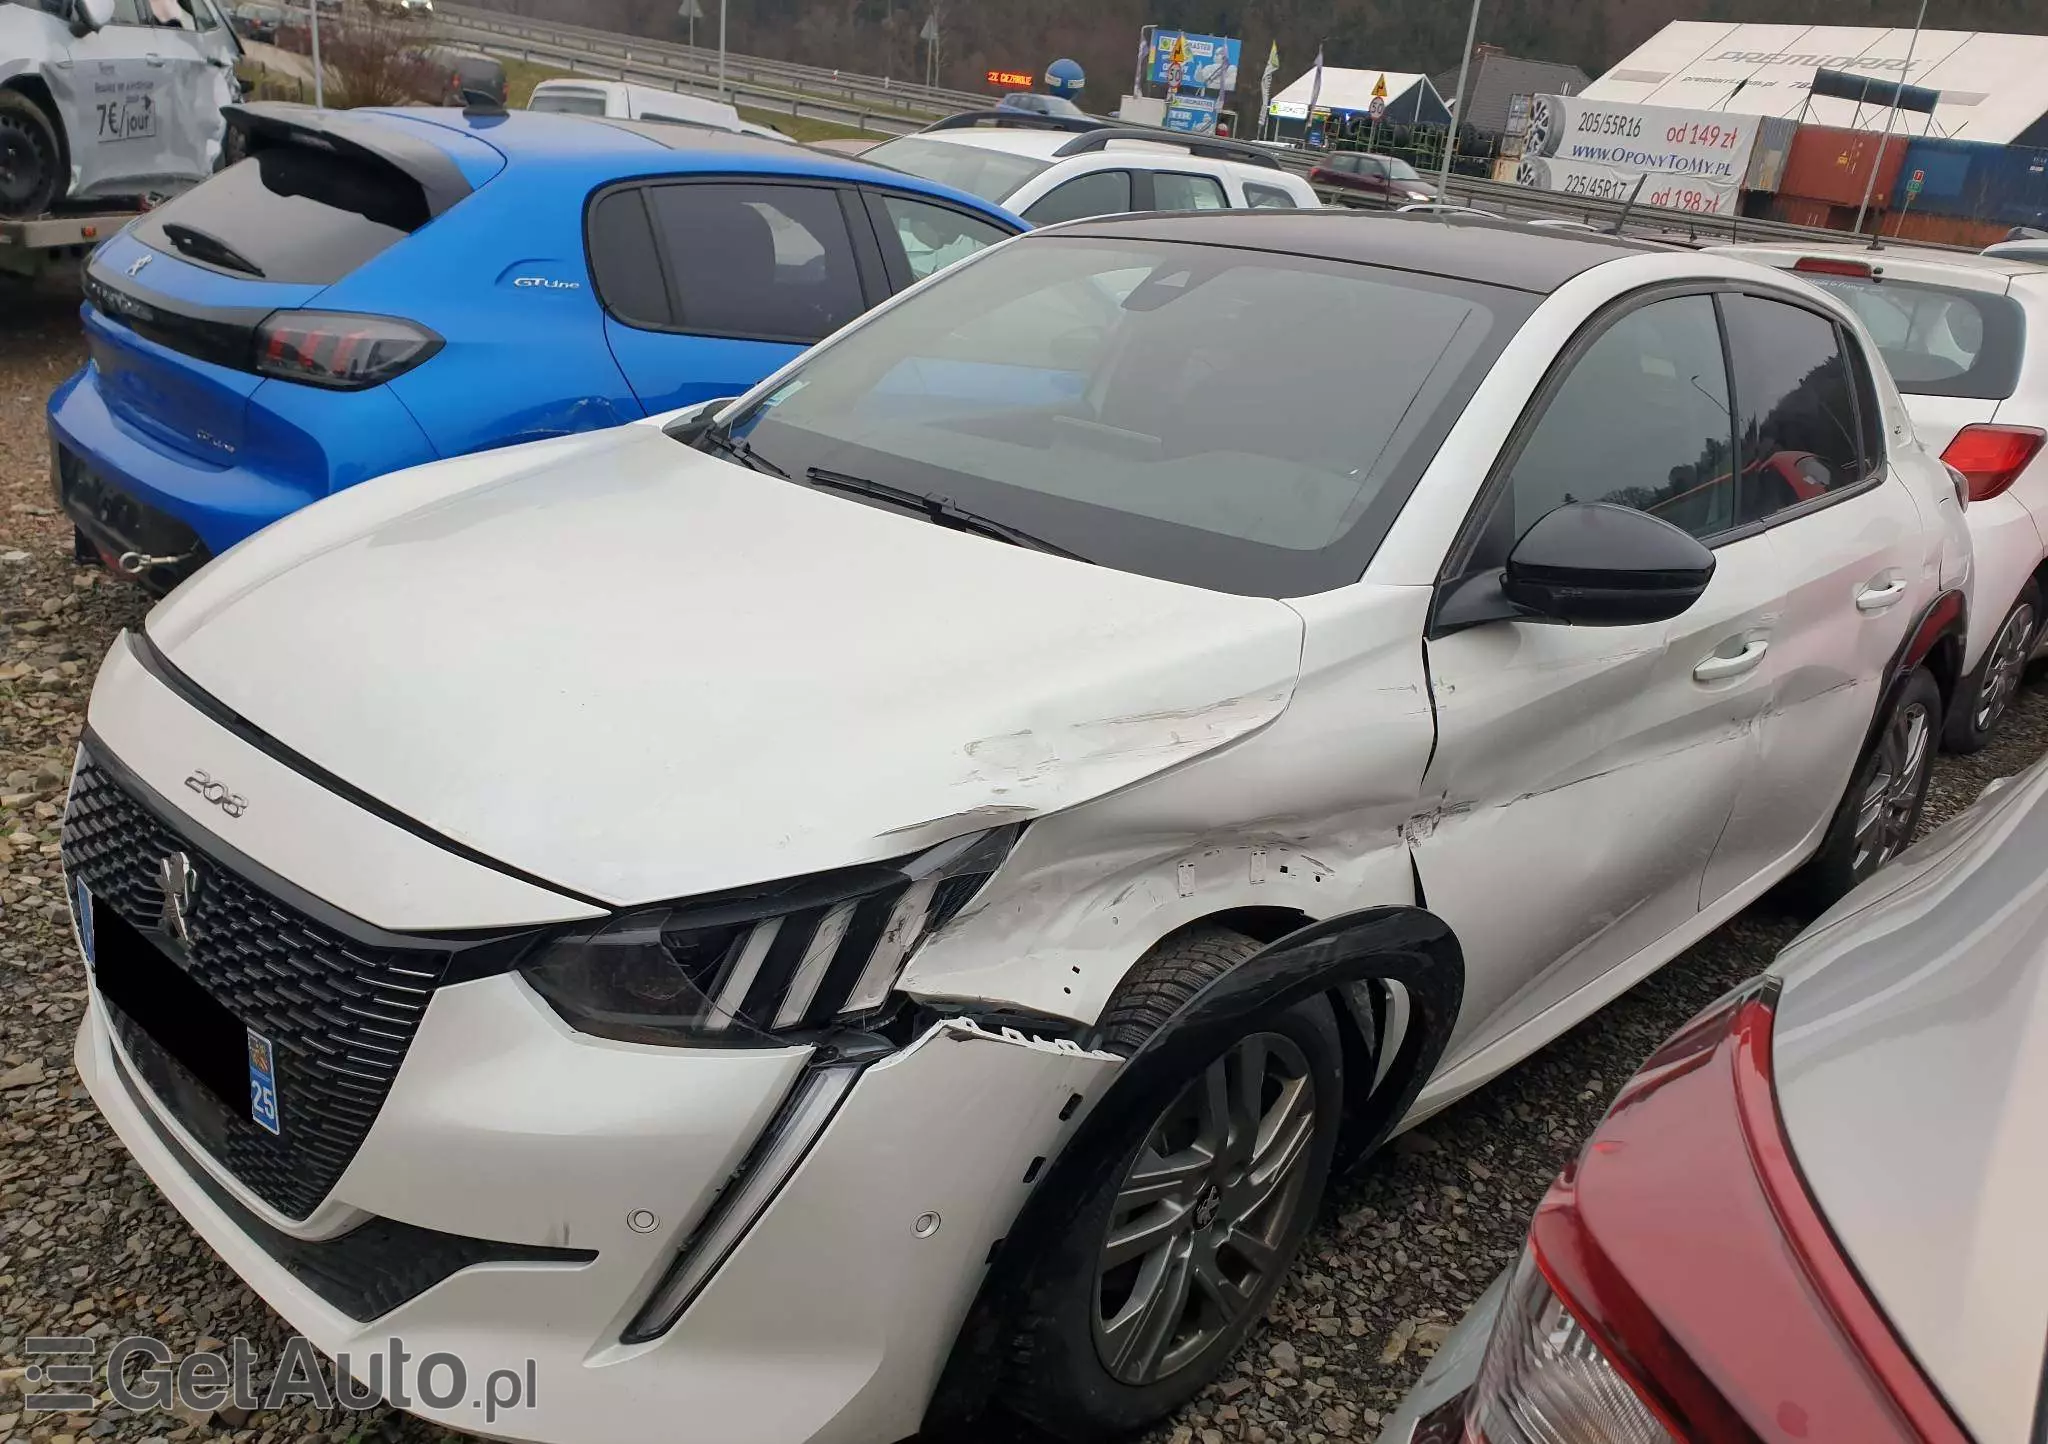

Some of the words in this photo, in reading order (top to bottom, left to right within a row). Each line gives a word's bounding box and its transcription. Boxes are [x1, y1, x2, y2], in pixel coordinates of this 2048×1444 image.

[97, 101, 150, 138] 7€/jour
[1371, 103, 1384, 114] 50
[1578, 112, 1642, 138] 205/55R16
[1666, 122, 1687, 143] od
[1689, 124, 1720, 147] 149
[1720, 127, 1738, 149] zł
[1564, 175, 1627, 200] 225/45R17
[1651, 187, 1671, 206] od
[1674, 189, 1702, 211] 198
[1703, 193, 1721, 213] zł
[184, 768, 249, 818] 208
[251, 1080, 275, 1120] 25
